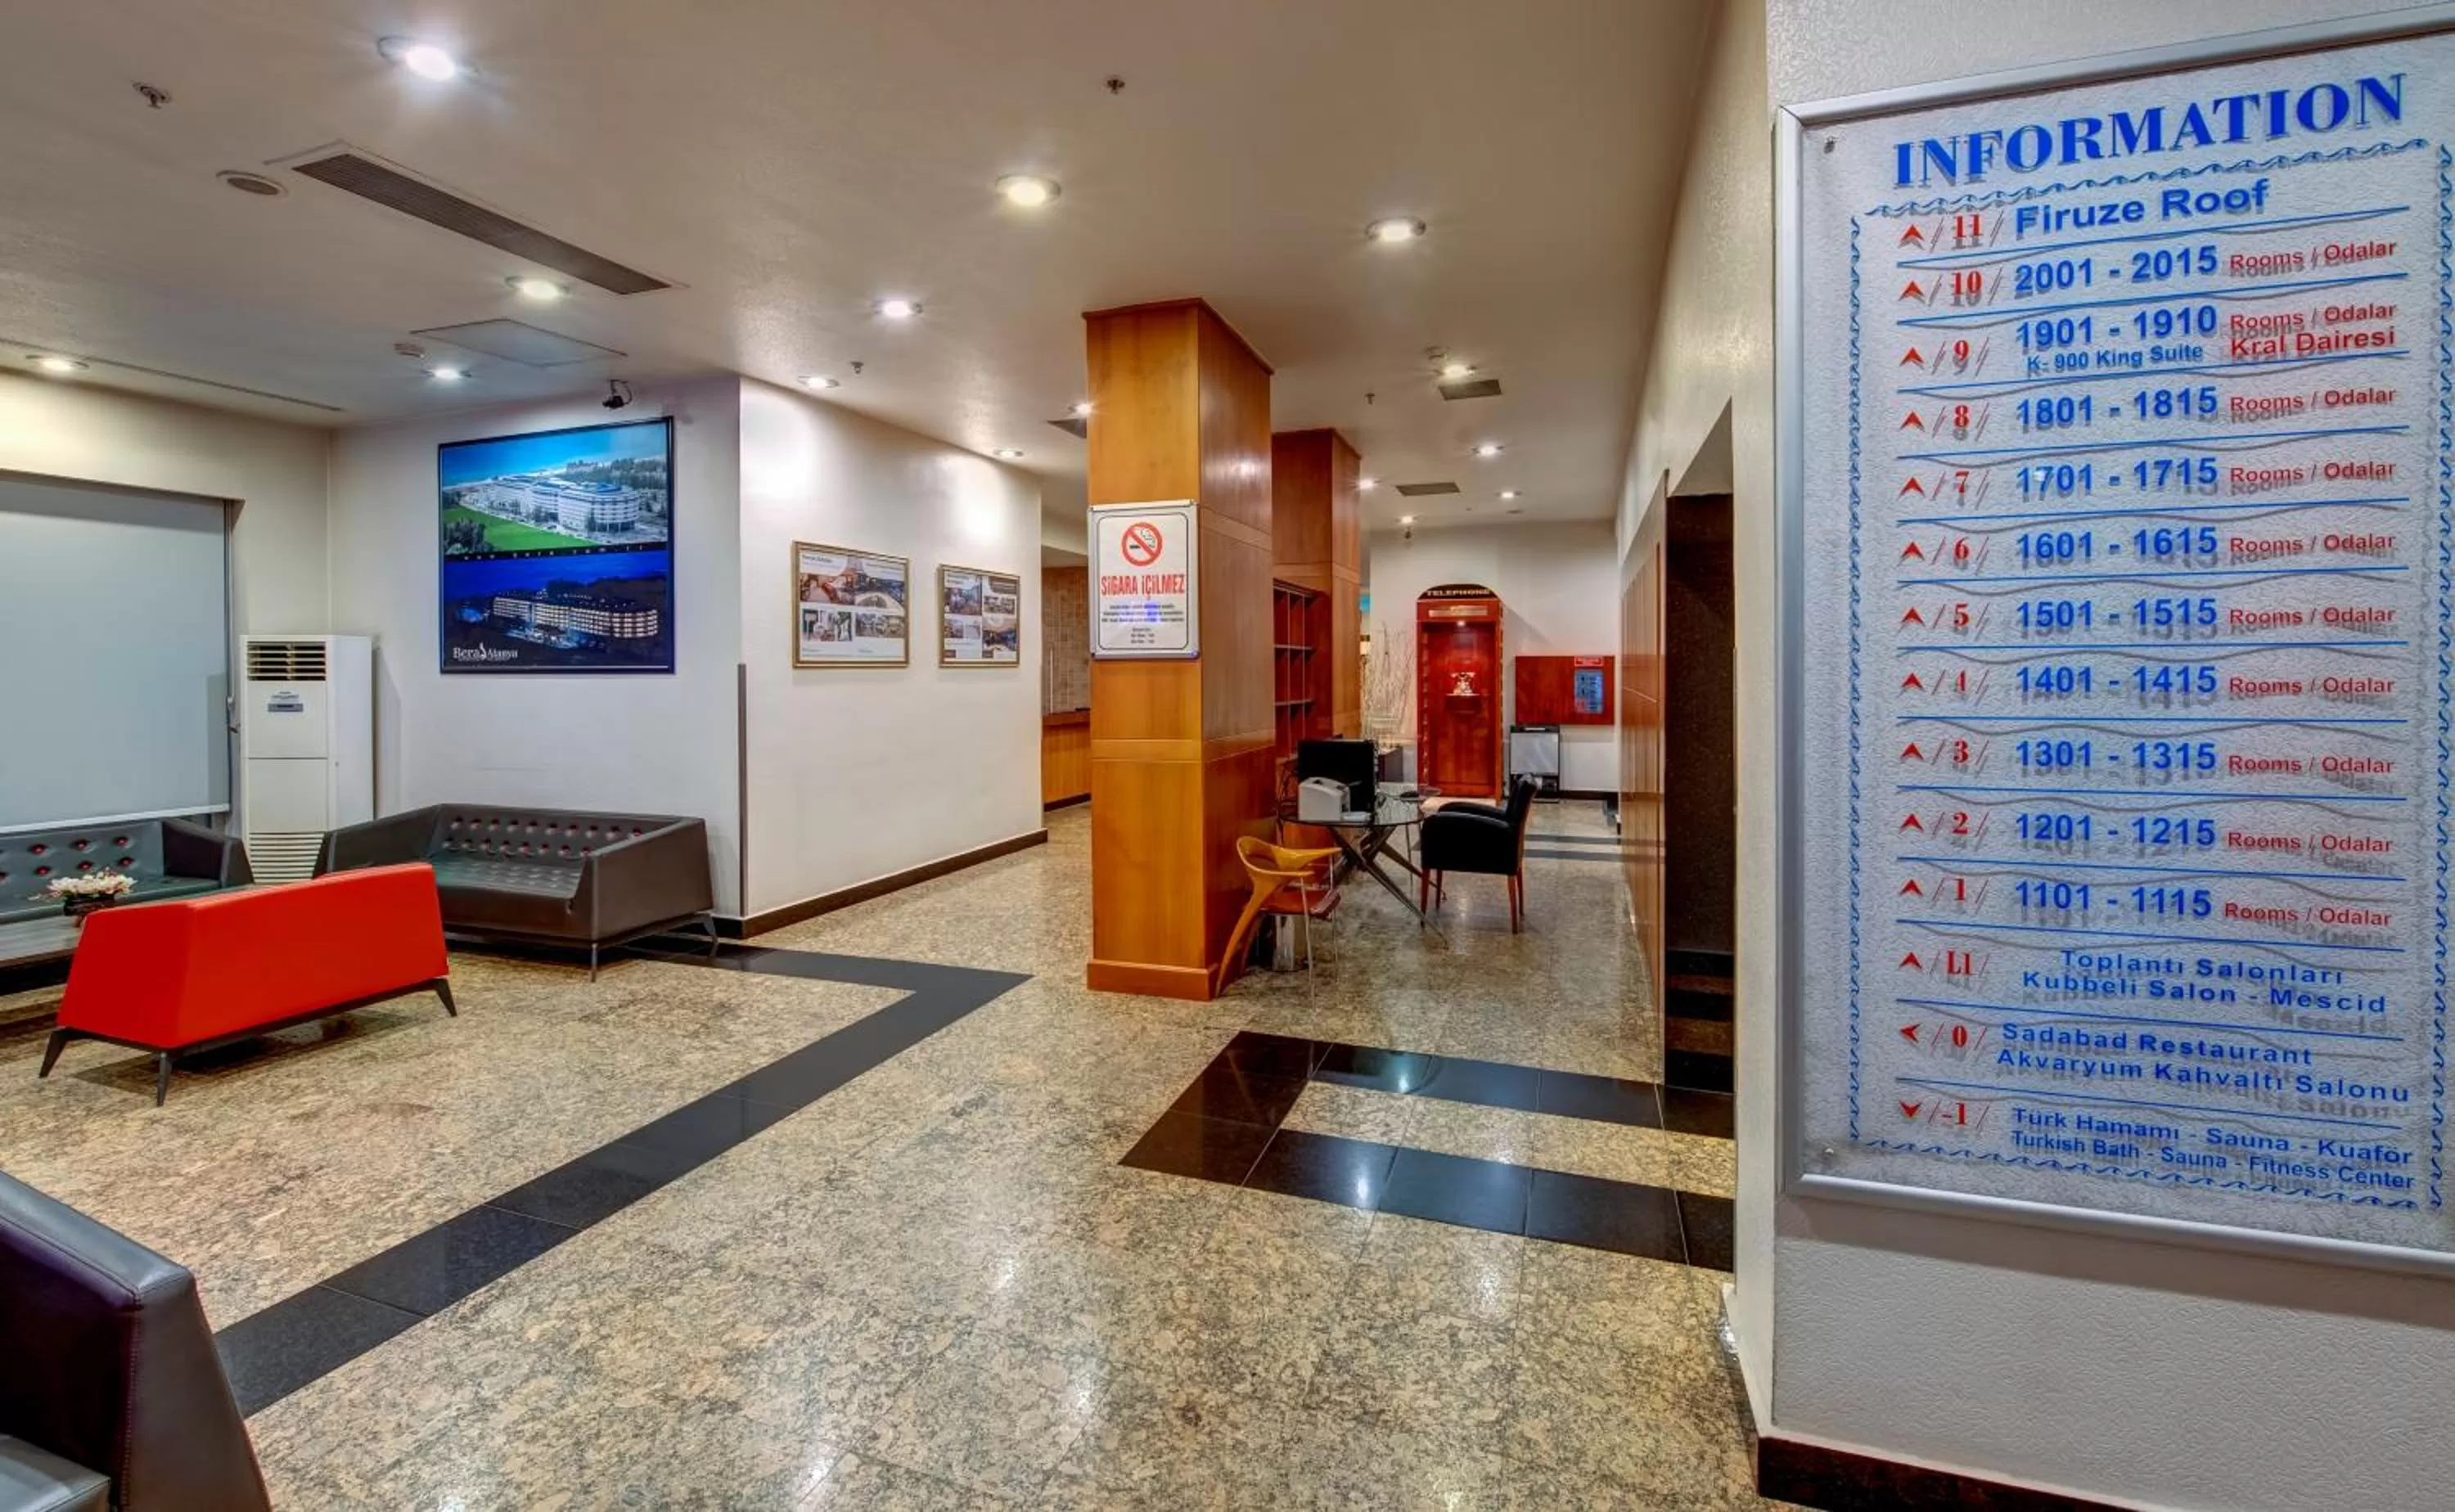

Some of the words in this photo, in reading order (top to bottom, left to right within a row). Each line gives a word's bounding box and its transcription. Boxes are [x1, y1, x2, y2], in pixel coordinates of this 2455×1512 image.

[1893, 73, 2407, 188] INFORMATION
[1952, 213, 1983, 239] 11
[2016, 199, 2145, 234] Firuze
[2161, 178, 2269, 218] Roof
[1952, 271, 1983, 295] 10
[2016, 258, 2092, 292] 2001
[2133, 245, 2217, 279] 2015
[2230, 250, 2304, 269] Rooms
[2325, 241, 2397, 261] Odalar
[1953, 340, 1970, 362] 9
[2016, 317, 2092, 348] 1901
[2134, 305, 2217, 339] 1910
[2230, 311, 2304, 329] Rooms
[2325, 304, 2397, 322] Odalar
[2097, 349, 2142, 368] King
[2150, 344, 2203, 362] Suite
[2231, 334, 2286, 357] Kral
[2296, 326, 2394, 352] Dairesi
[1953, 405, 1970, 428] 8
[2016, 395, 2092, 425] 1801
[2134, 386, 2217, 419] 1815
[2230, 395, 2304, 412] Rooms
[2325, 388, 2397, 406] Odalar
[1953, 470, 1970, 493] 7
[2016, 464, 2092, 493] 1701
[2134, 457, 2217, 487] 1715
[2230, 466, 2304, 482] Rooms
[2324, 462, 2397, 479] Odalar
[1953, 537, 1970, 560] 6
[2016, 532, 2092, 559] 1601
[2134, 527, 2217, 556] 1615
[2230, 537, 2304, 552] Rooms
[2324, 534, 2397, 551] Odalar
[1953, 604, 1970, 627] 5
[2016, 600, 2092, 628] 1501
[2133, 598, 2217, 626] 1515
[2229, 608, 2304, 623] Rooms
[2323, 607, 2397, 623] Odalar
[2016, 666, 2092, 693] 1401
[2133, 666, 2217, 693] 1415
[2229, 677, 2303, 694] Rooms
[2323, 677, 2395, 694] Odalar
[1953, 740, 1970, 763] 3
[2016, 740, 2091, 767] 1301
[2133, 742, 2216, 770] 1315
[2228, 755, 2302, 772] Rooms
[2322, 757, 2394, 773] Odalar
[1952, 812, 1969, 835] 2
[2016, 813, 2091, 841] 1201
[2133, 817, 2215, 846] 1215
[2228, 832, 2301, 849] Rooms
[2322, 835, 2394, 853] Odalar
[1954, 878, 1966, 902] 1
[2016, 881, 2090, 910] 1101
[2132, 887, 2211, 916] 1115
[2225, 903, 2299, 921] Rooms
[2320, 907, 2392, 925] Odalar
[2023, 971, 2136, 995] Kubbeli
[2150, 980, 2236, 1002] Salon
[2271, 987, 2385, 1012] Mescid
[1952, 1025, 1968, 1048] 0
[2002, 1023, 2127, 1050] Sadabad
[2139, 1034, 2312, 1064] Restaurant
[1997, 1049, 2142, 1078] Akvaryum
[2296, 1076, 2408, 1101] Salonu
[2012, 1130, 2085, 1152] Turkish
[2092, 1139, 2140, 1159] Bath
[2161, 1146, 2227, 1168] Sauna
[2250, 1156, 2329, 1179] Fitness
[2338, 1166, 2414, 1188] Center
[2206, 1128, 2289, 1151] Sauna
[2318, 1138, 2412, 1164] Kuaför
